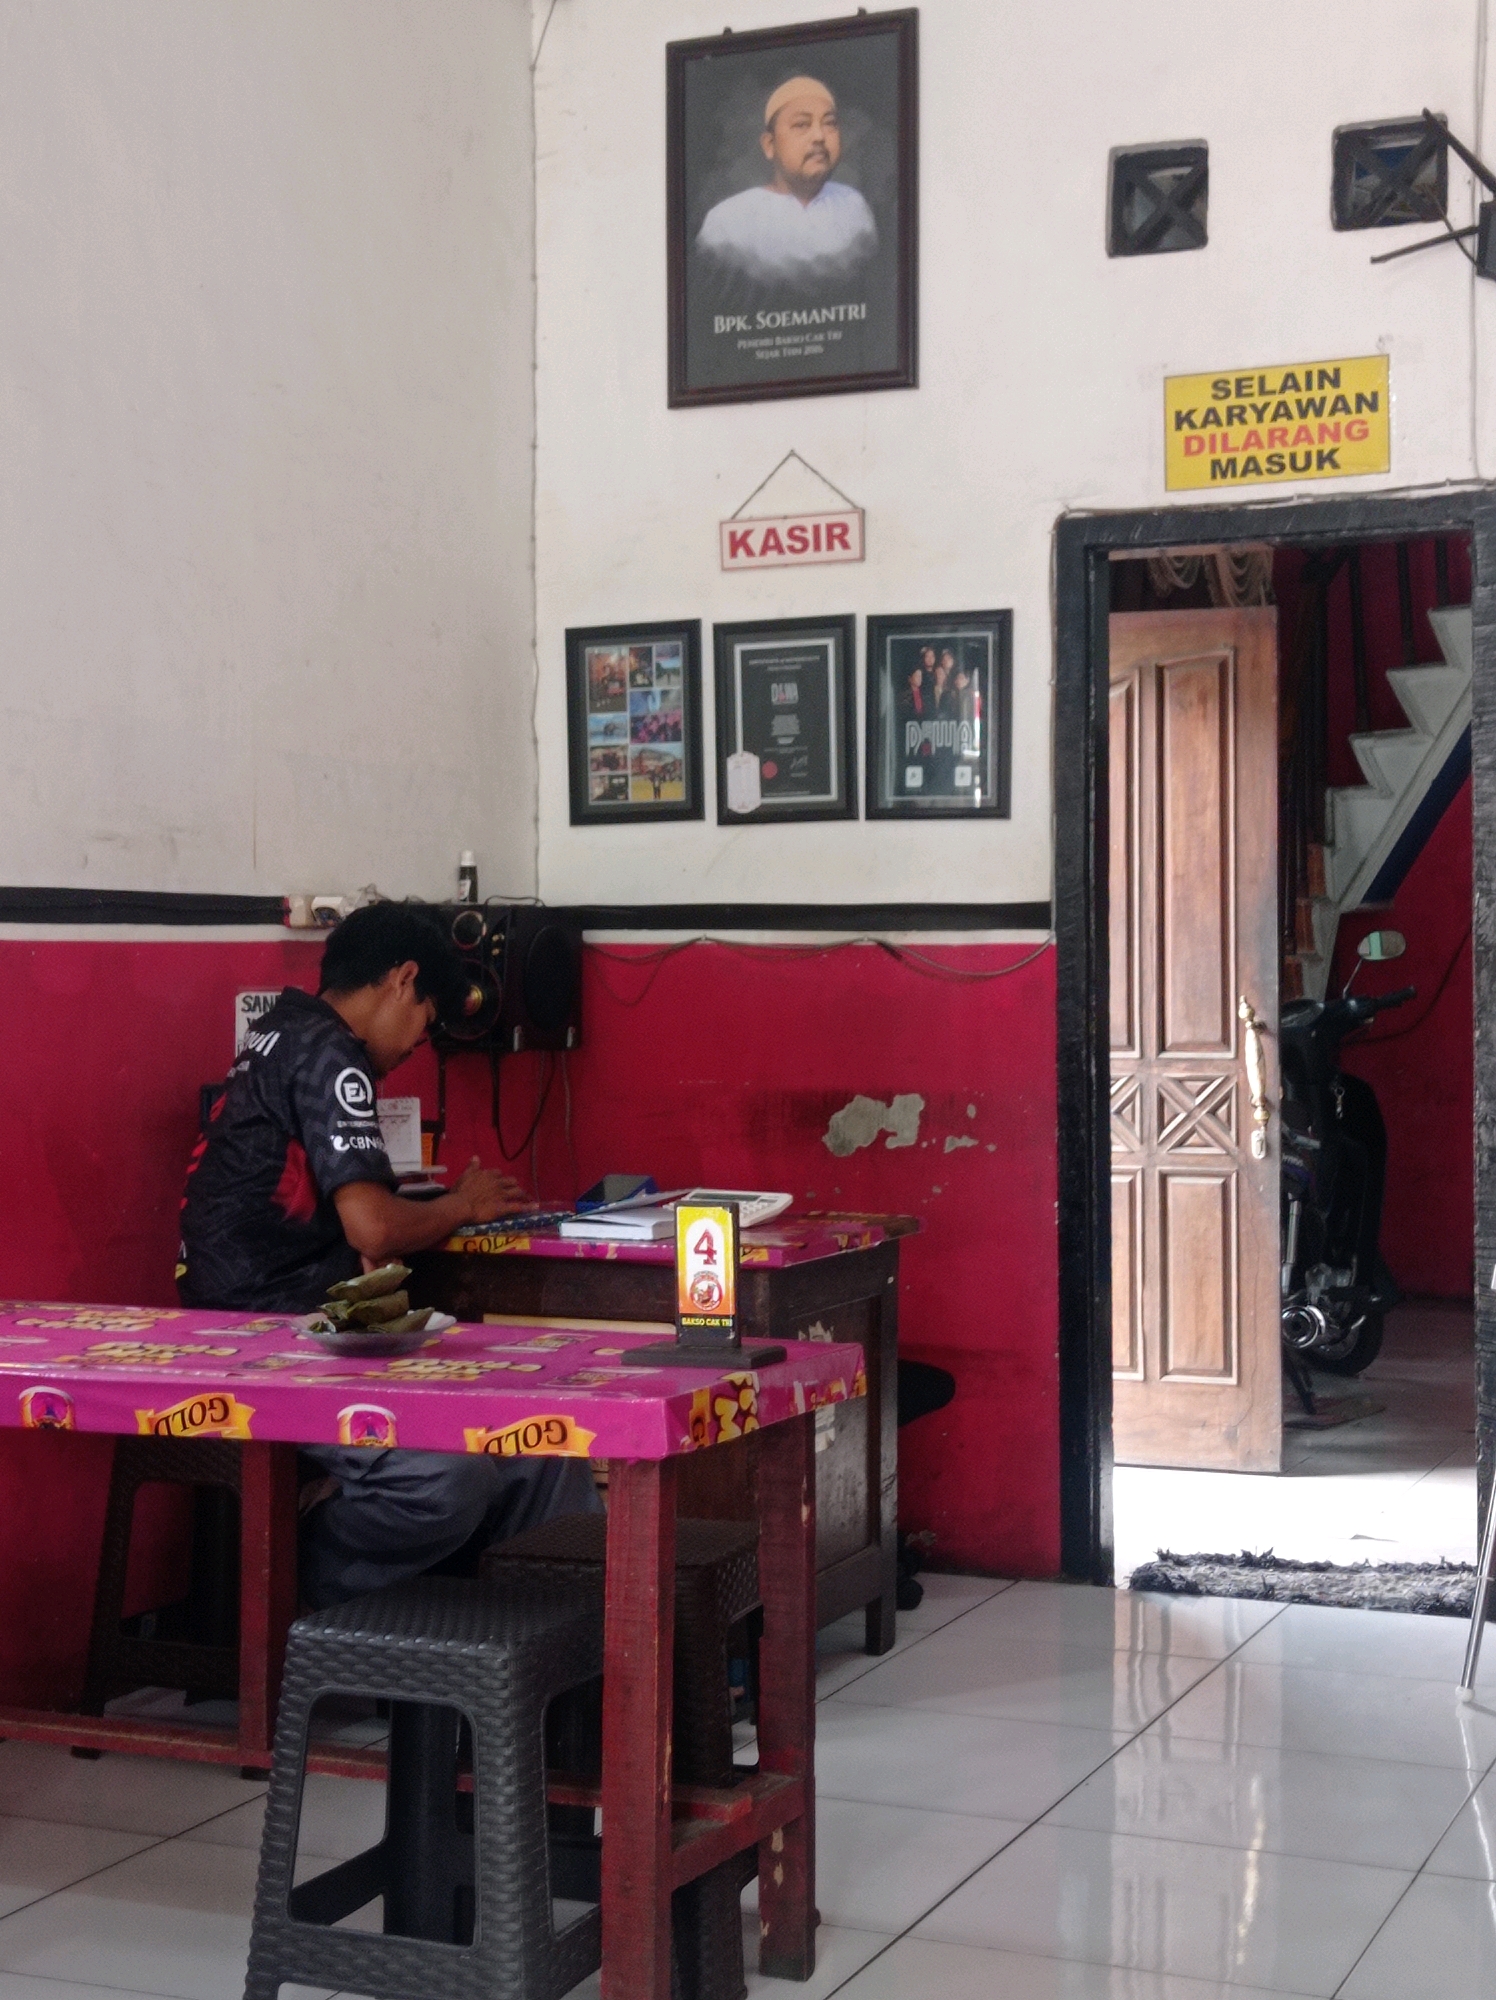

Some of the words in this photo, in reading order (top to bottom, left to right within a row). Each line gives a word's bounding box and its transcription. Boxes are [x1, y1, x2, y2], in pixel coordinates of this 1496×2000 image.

[755, 302, 867, 330] SOEMANTRI
[1211, 367, 1341, 401] SELAIN
[1174, 391, 1379, 432] KARYAWAN
[1183, 419, 1370, 457] DILARANG
[1210, 447, 1341, 481] MASUK
[728, 521, 852, 560] KASIR
[693, 1228, 718, 1266] 4
[154, 1396, 230, 1436] GOLD
[483, 1418, 568, 1454] GOLD
